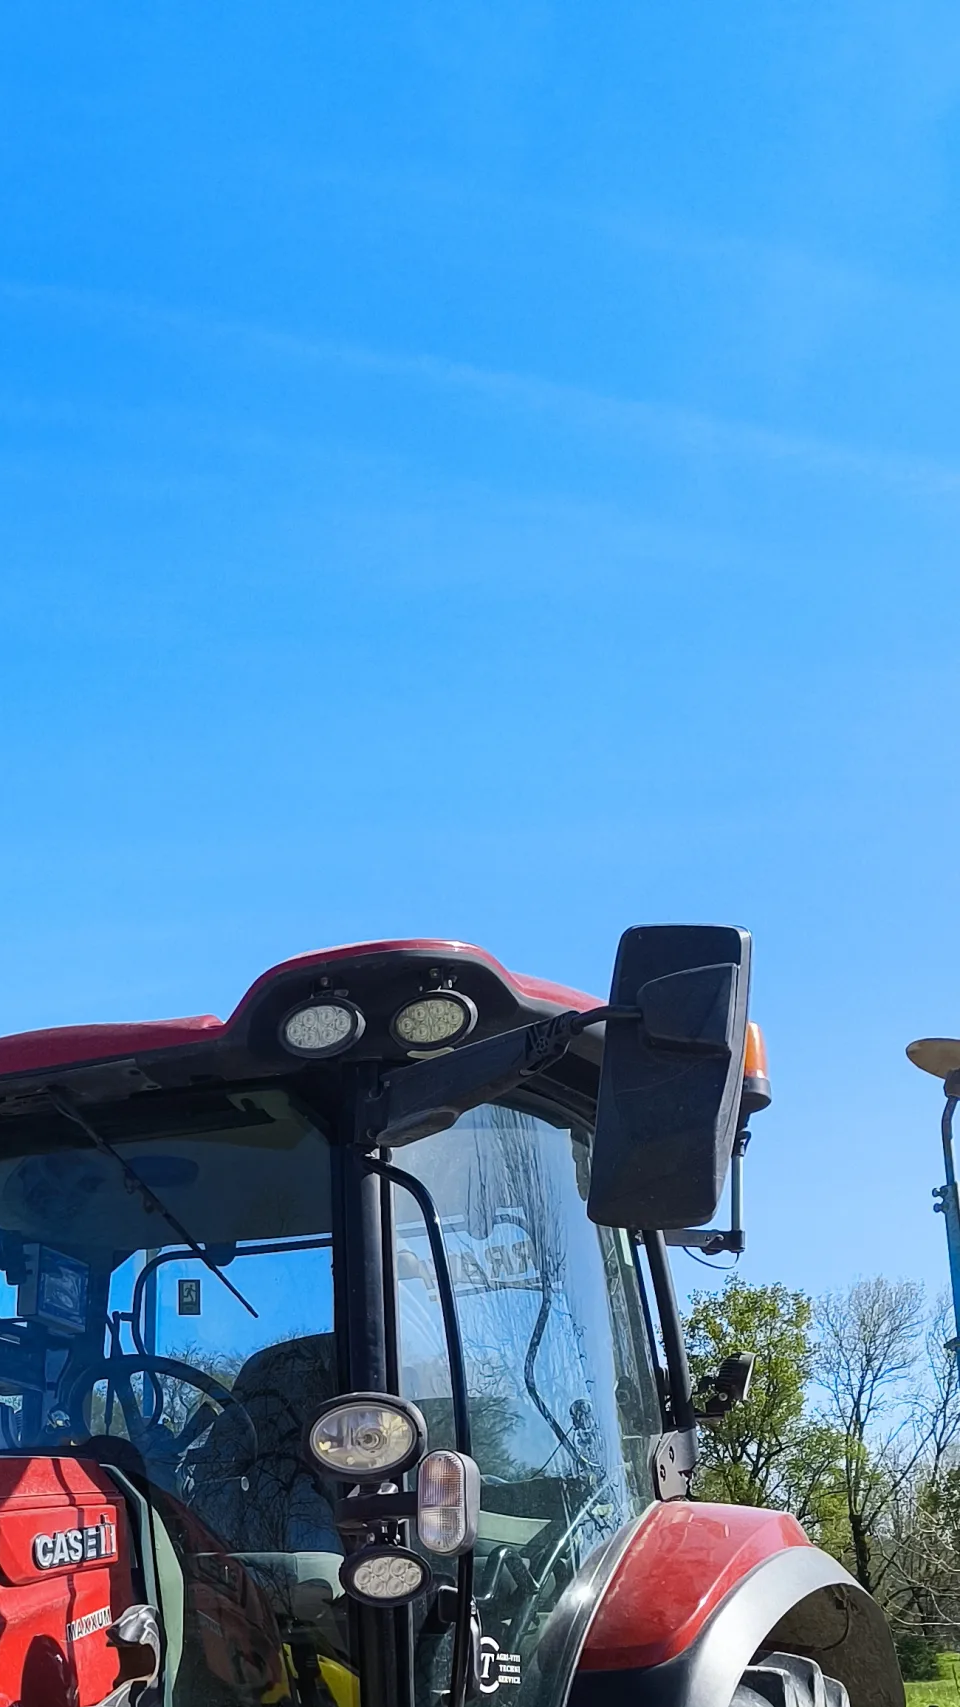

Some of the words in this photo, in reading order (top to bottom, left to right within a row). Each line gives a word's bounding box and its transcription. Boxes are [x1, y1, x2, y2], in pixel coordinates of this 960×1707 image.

[31, 1527, 97, 1569] CASE
[67, 1606, 113, 1641] MAXXUM
[497, 1674, 522, 1685] SERVICE
